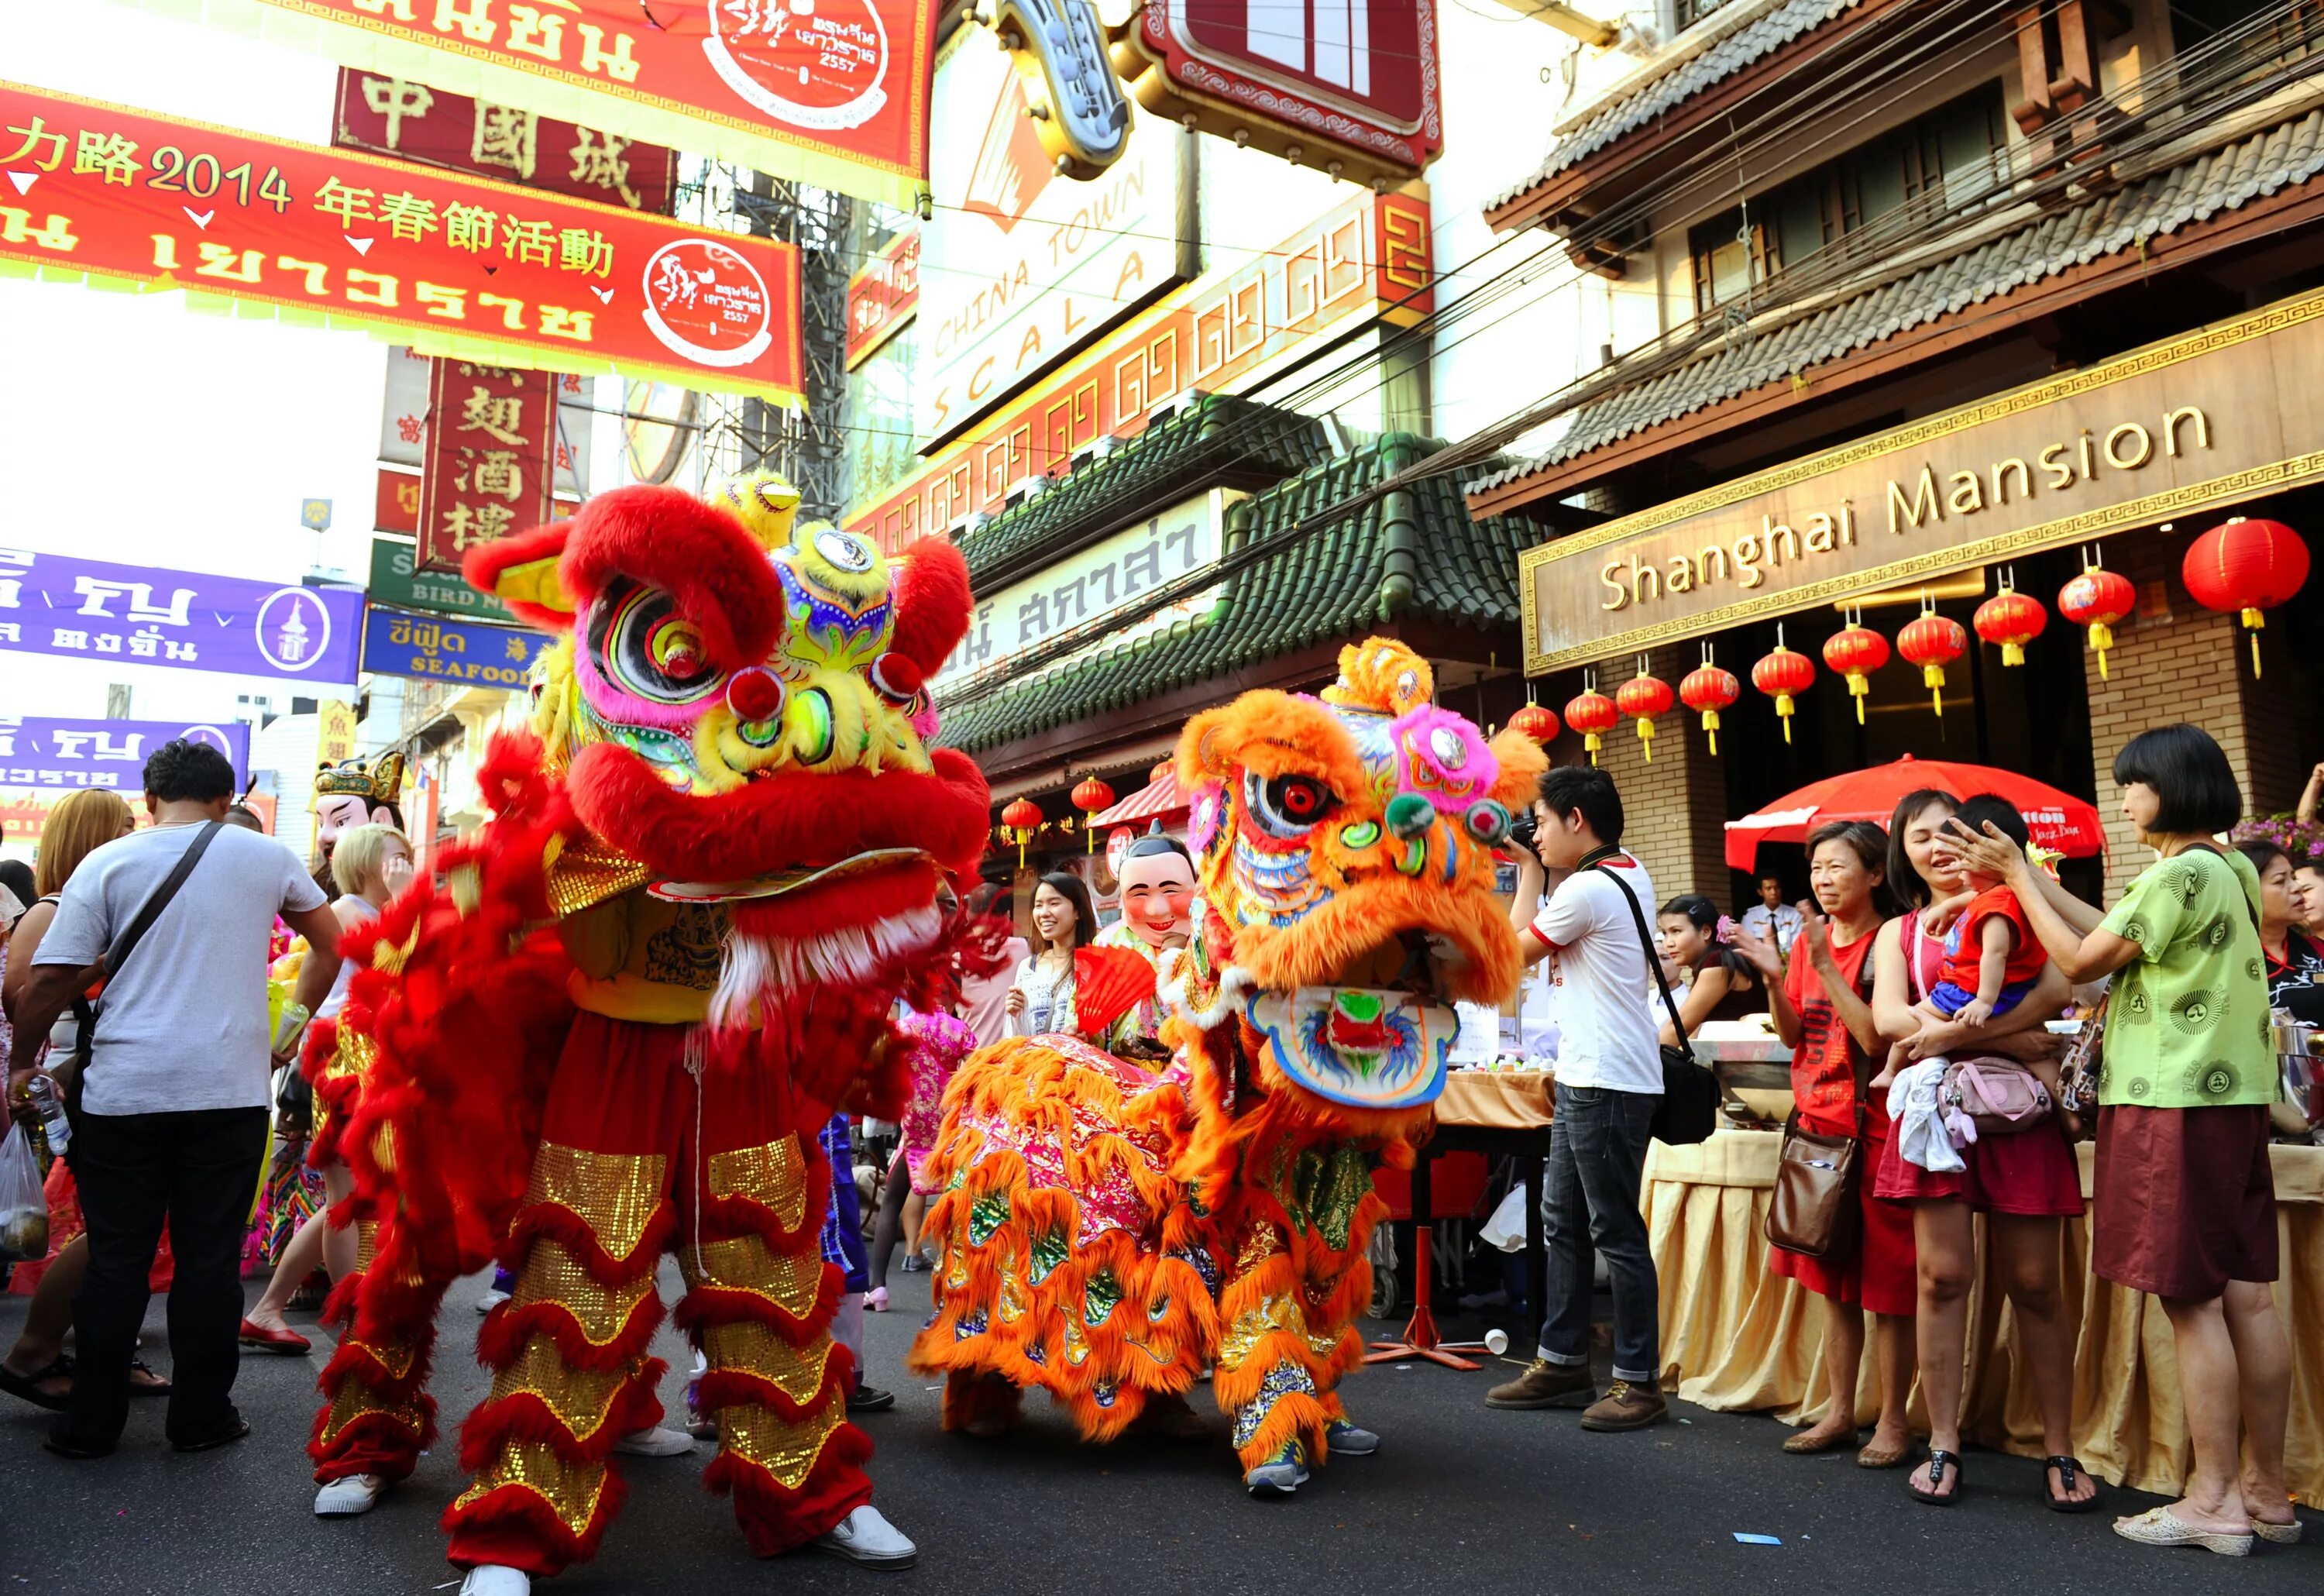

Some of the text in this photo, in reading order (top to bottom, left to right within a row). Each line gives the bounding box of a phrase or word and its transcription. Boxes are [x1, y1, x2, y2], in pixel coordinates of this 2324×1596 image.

[819, 52, 858, 73] 2557
[361, 76, 641, 209] 中國城
[146, 146, 293, 214] 2014
[313, 175, 614, 279] 年春節活動
[934, 260, 1029, 358] CHINA
[1047, 158, 1144, 267] TOWN
[150, 234, 596, 342] เยาวราช
[723, 310, 749, 323] 2557
[933, 250, 1144, 430] SCALA
[442, 361, 530, 552] 翅酒樓
[1600, 405, 2212, 611] Shanghai Mansion
[412, 583, 475, 607] BIRD
[411, 656, 532, 686] SEAFOOD
